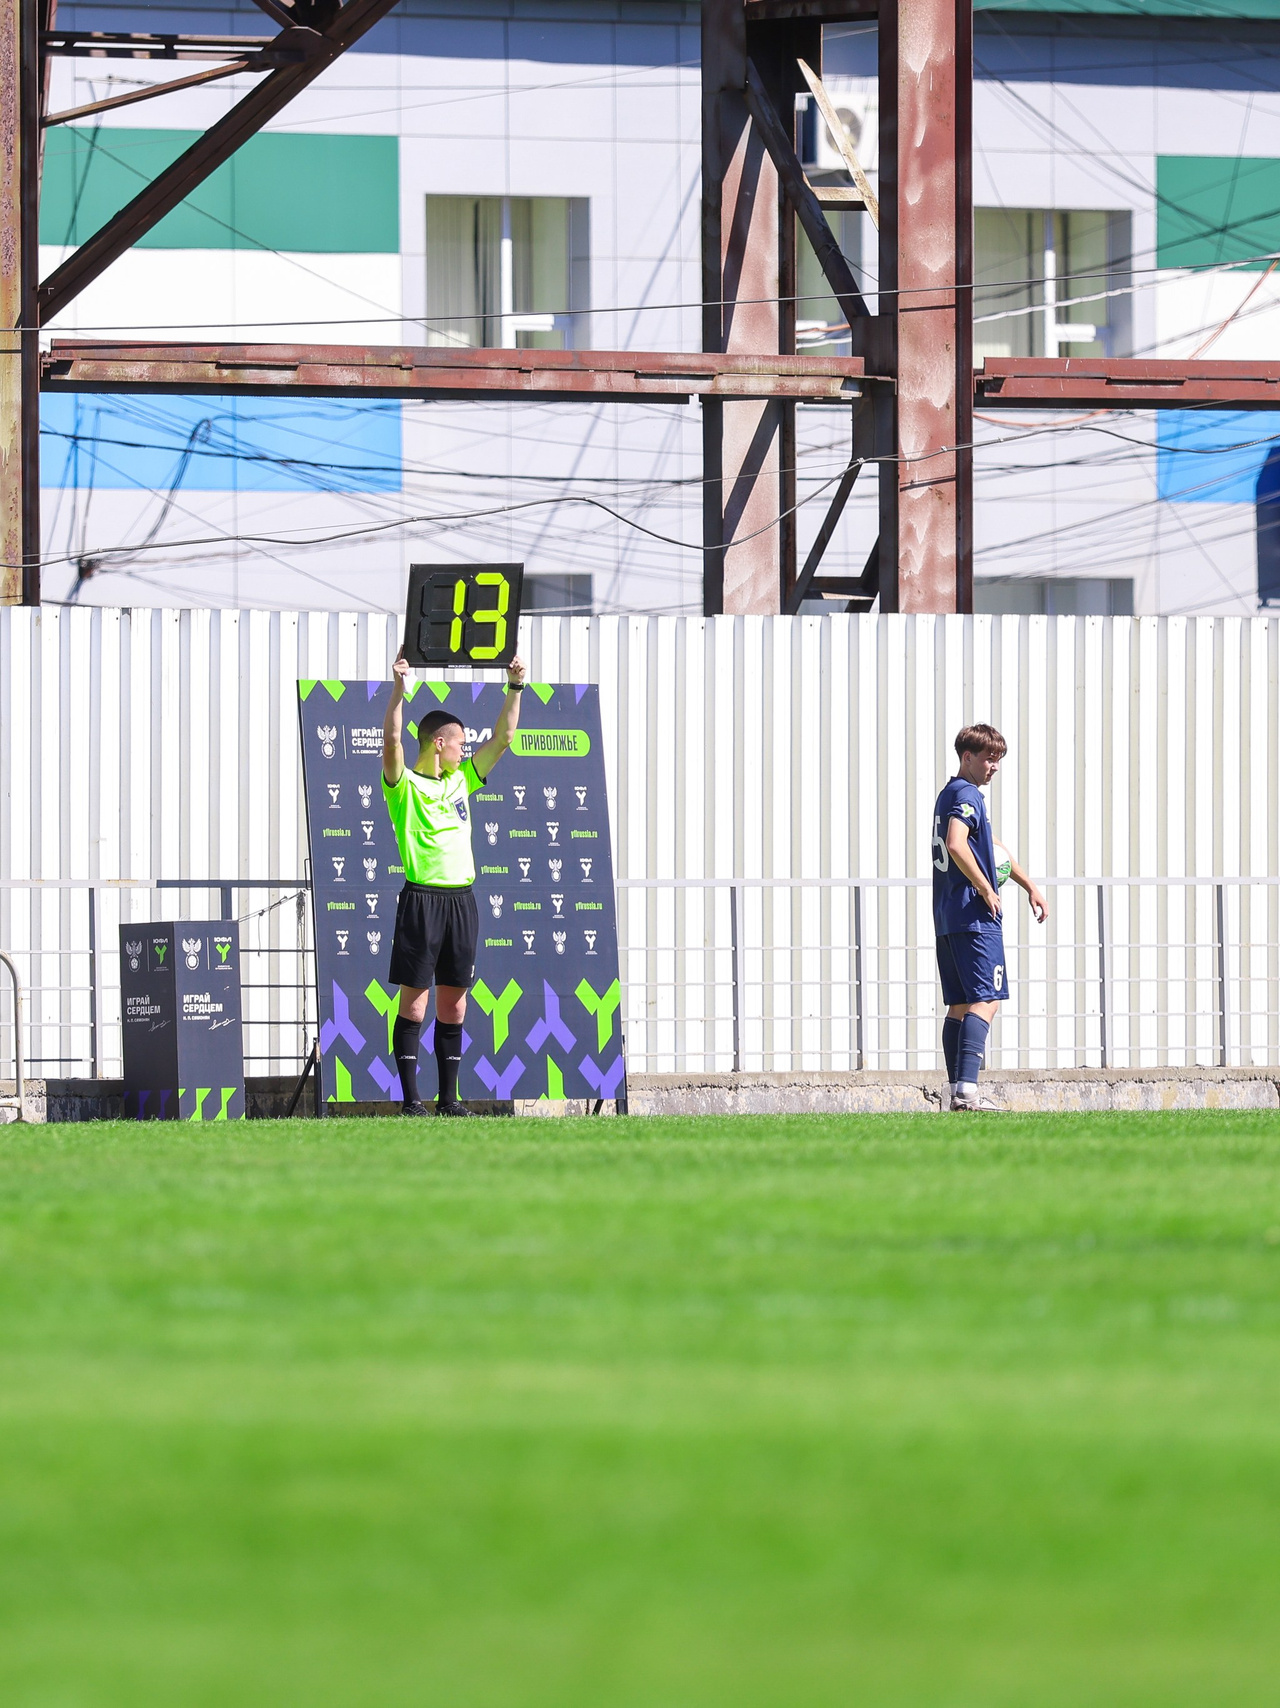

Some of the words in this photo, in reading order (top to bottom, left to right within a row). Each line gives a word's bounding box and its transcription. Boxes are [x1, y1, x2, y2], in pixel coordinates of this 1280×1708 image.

[449, 572, 510, 660] 13
[351, 737, 385, 749] СЕРДЦЕ
[520, 733, 579, 752] ПРИВОЛЖЬЕ
[126, 994, 150, 1006] ИГРАЙ
[182, 992, 211, 1004] ИГРАЙ
[126, 1005, 161, 1017] СЕРДЦЕМ
[182, 1003, 223, 1015] СЕРДЦЕМ
